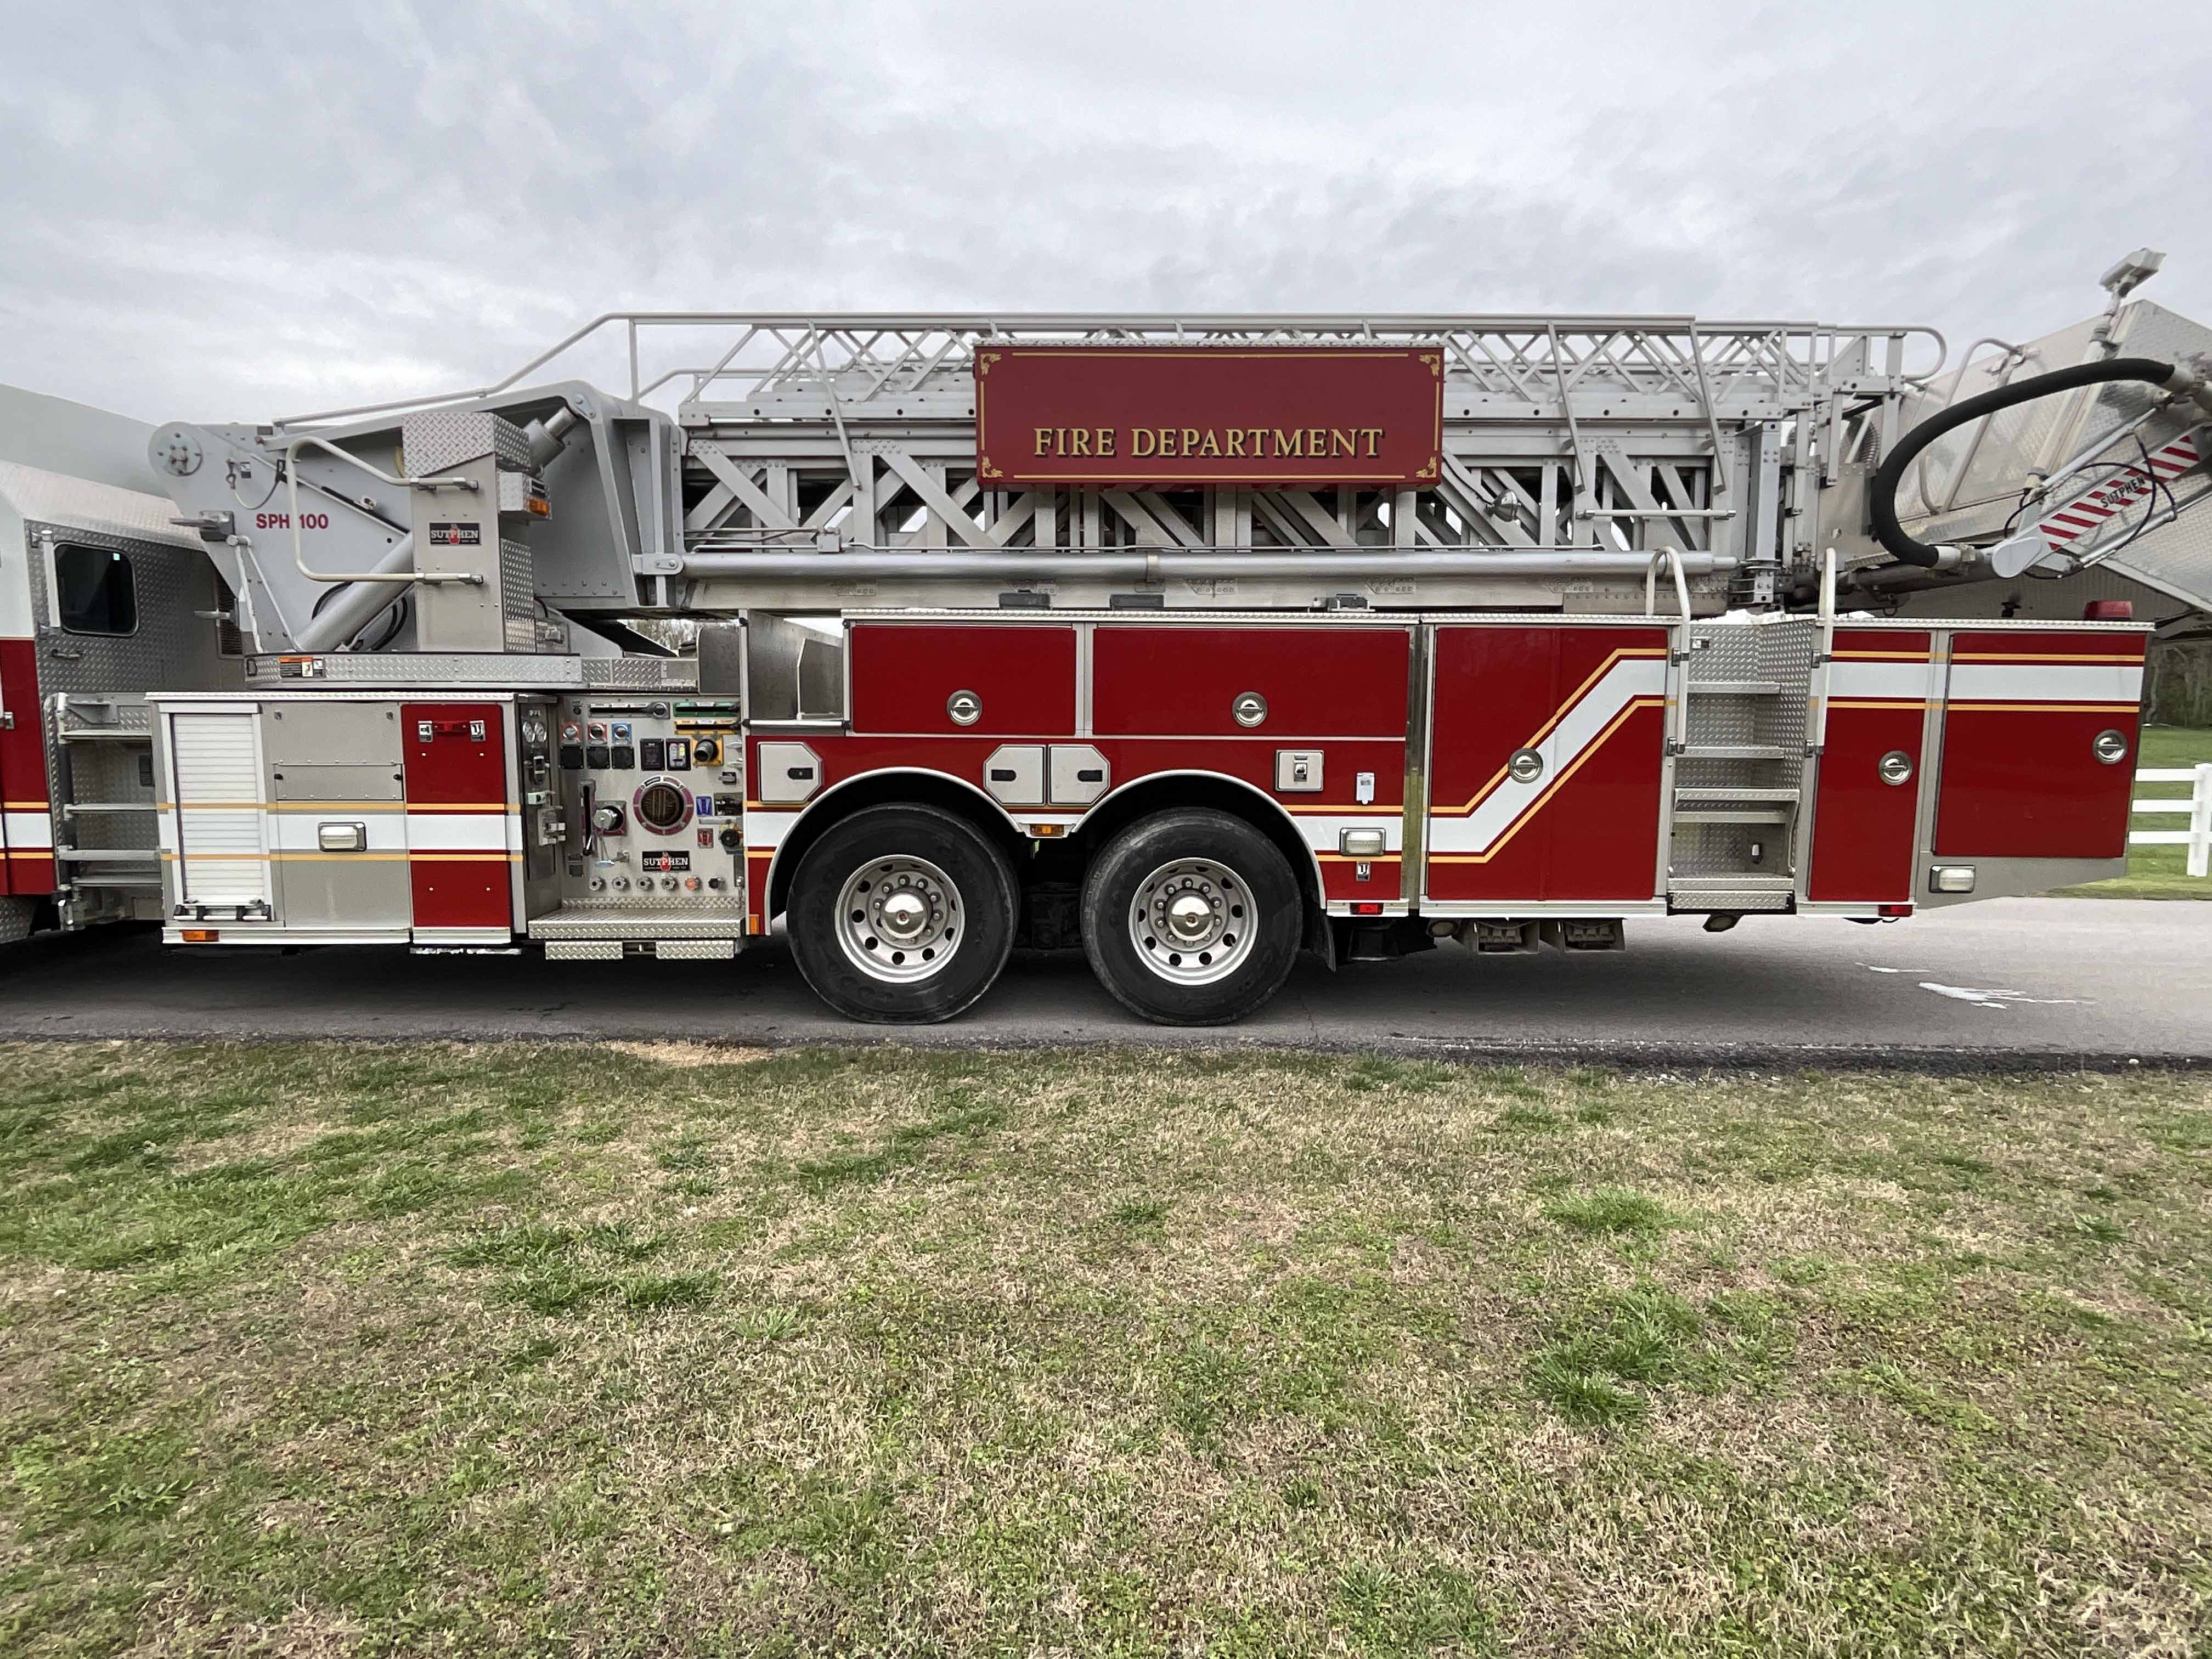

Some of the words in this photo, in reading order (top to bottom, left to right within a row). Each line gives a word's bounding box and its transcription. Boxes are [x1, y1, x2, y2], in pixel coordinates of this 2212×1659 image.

[1034, 427, 1116, 457] FIRE
[1131, 428, 1384, 457] DEPARTMENT
[2101, 475, 2145, 507] SUTPHEN
[256, 513, 290, 529] SPH
[298, 514, 329, 529] 100
[430, 530, 478, 538] SUTPHEN
[644, 857, 689, 866] SUTPHEN
